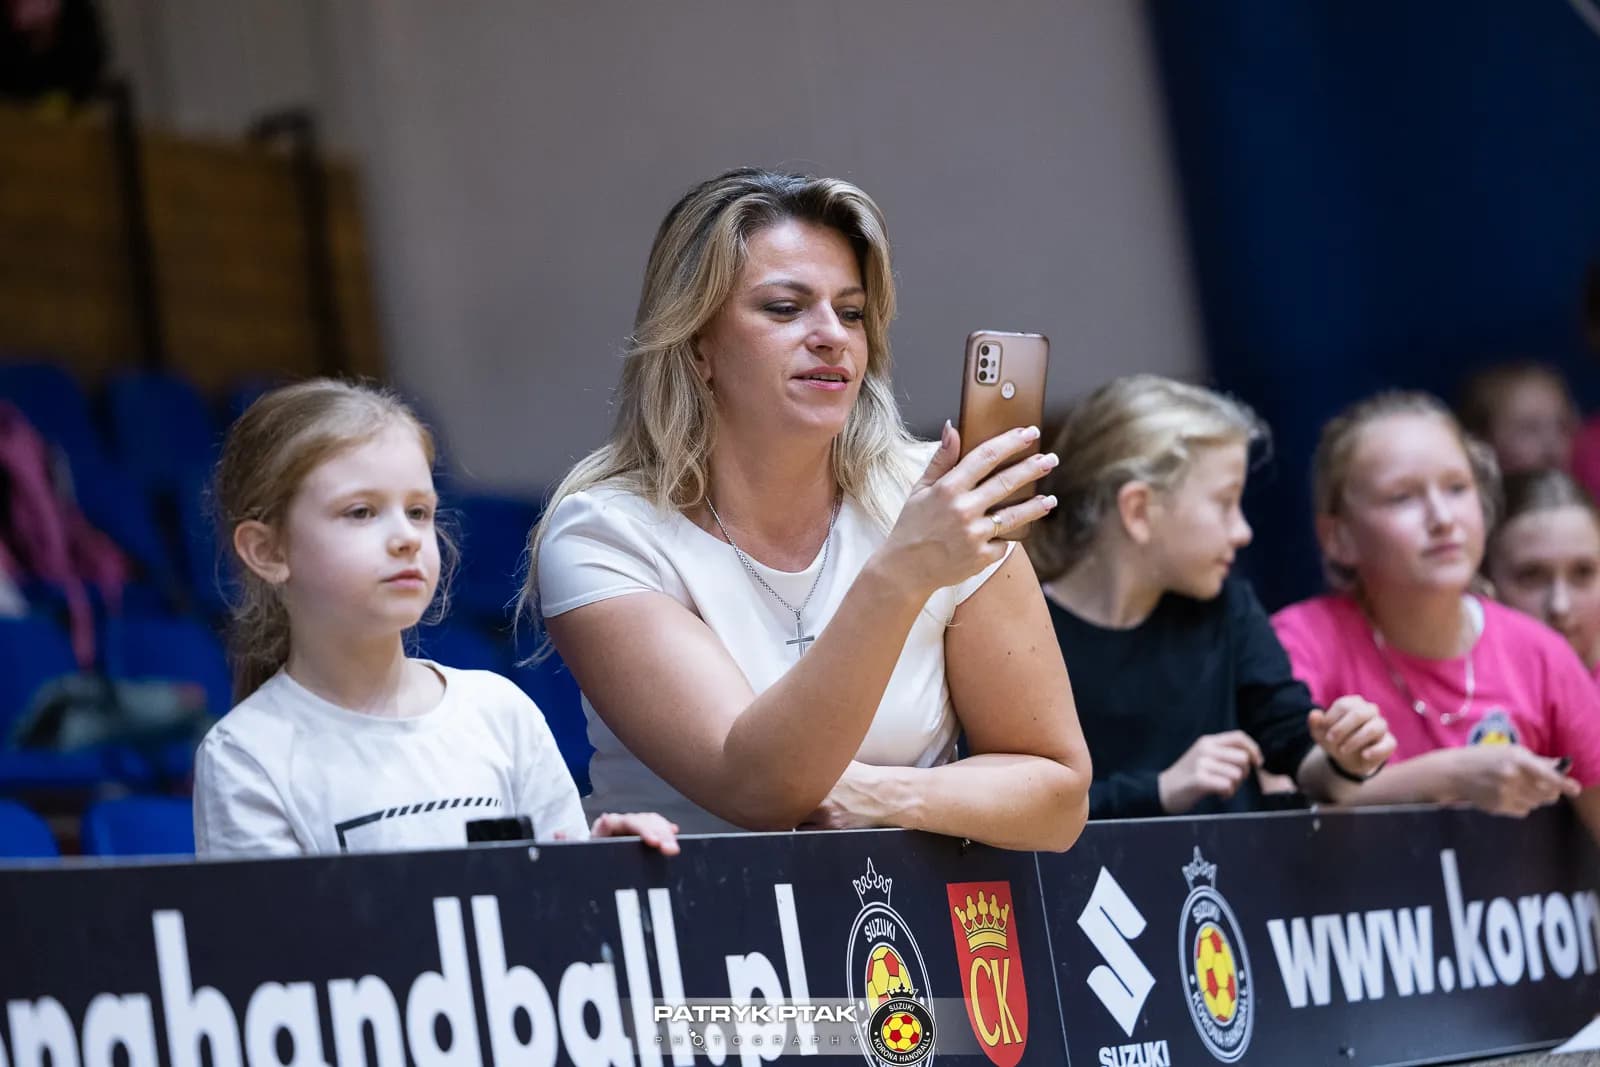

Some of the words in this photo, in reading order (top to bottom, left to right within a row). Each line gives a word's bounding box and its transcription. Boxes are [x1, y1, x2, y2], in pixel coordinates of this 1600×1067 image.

[864, 917, 896, 943] SUZUKI
[0, 884, 818, 1067] nahandball.pl
[970, 957, 1024, 1046] CK
[1098, 1040, 1171, 1067] SUZUKI
